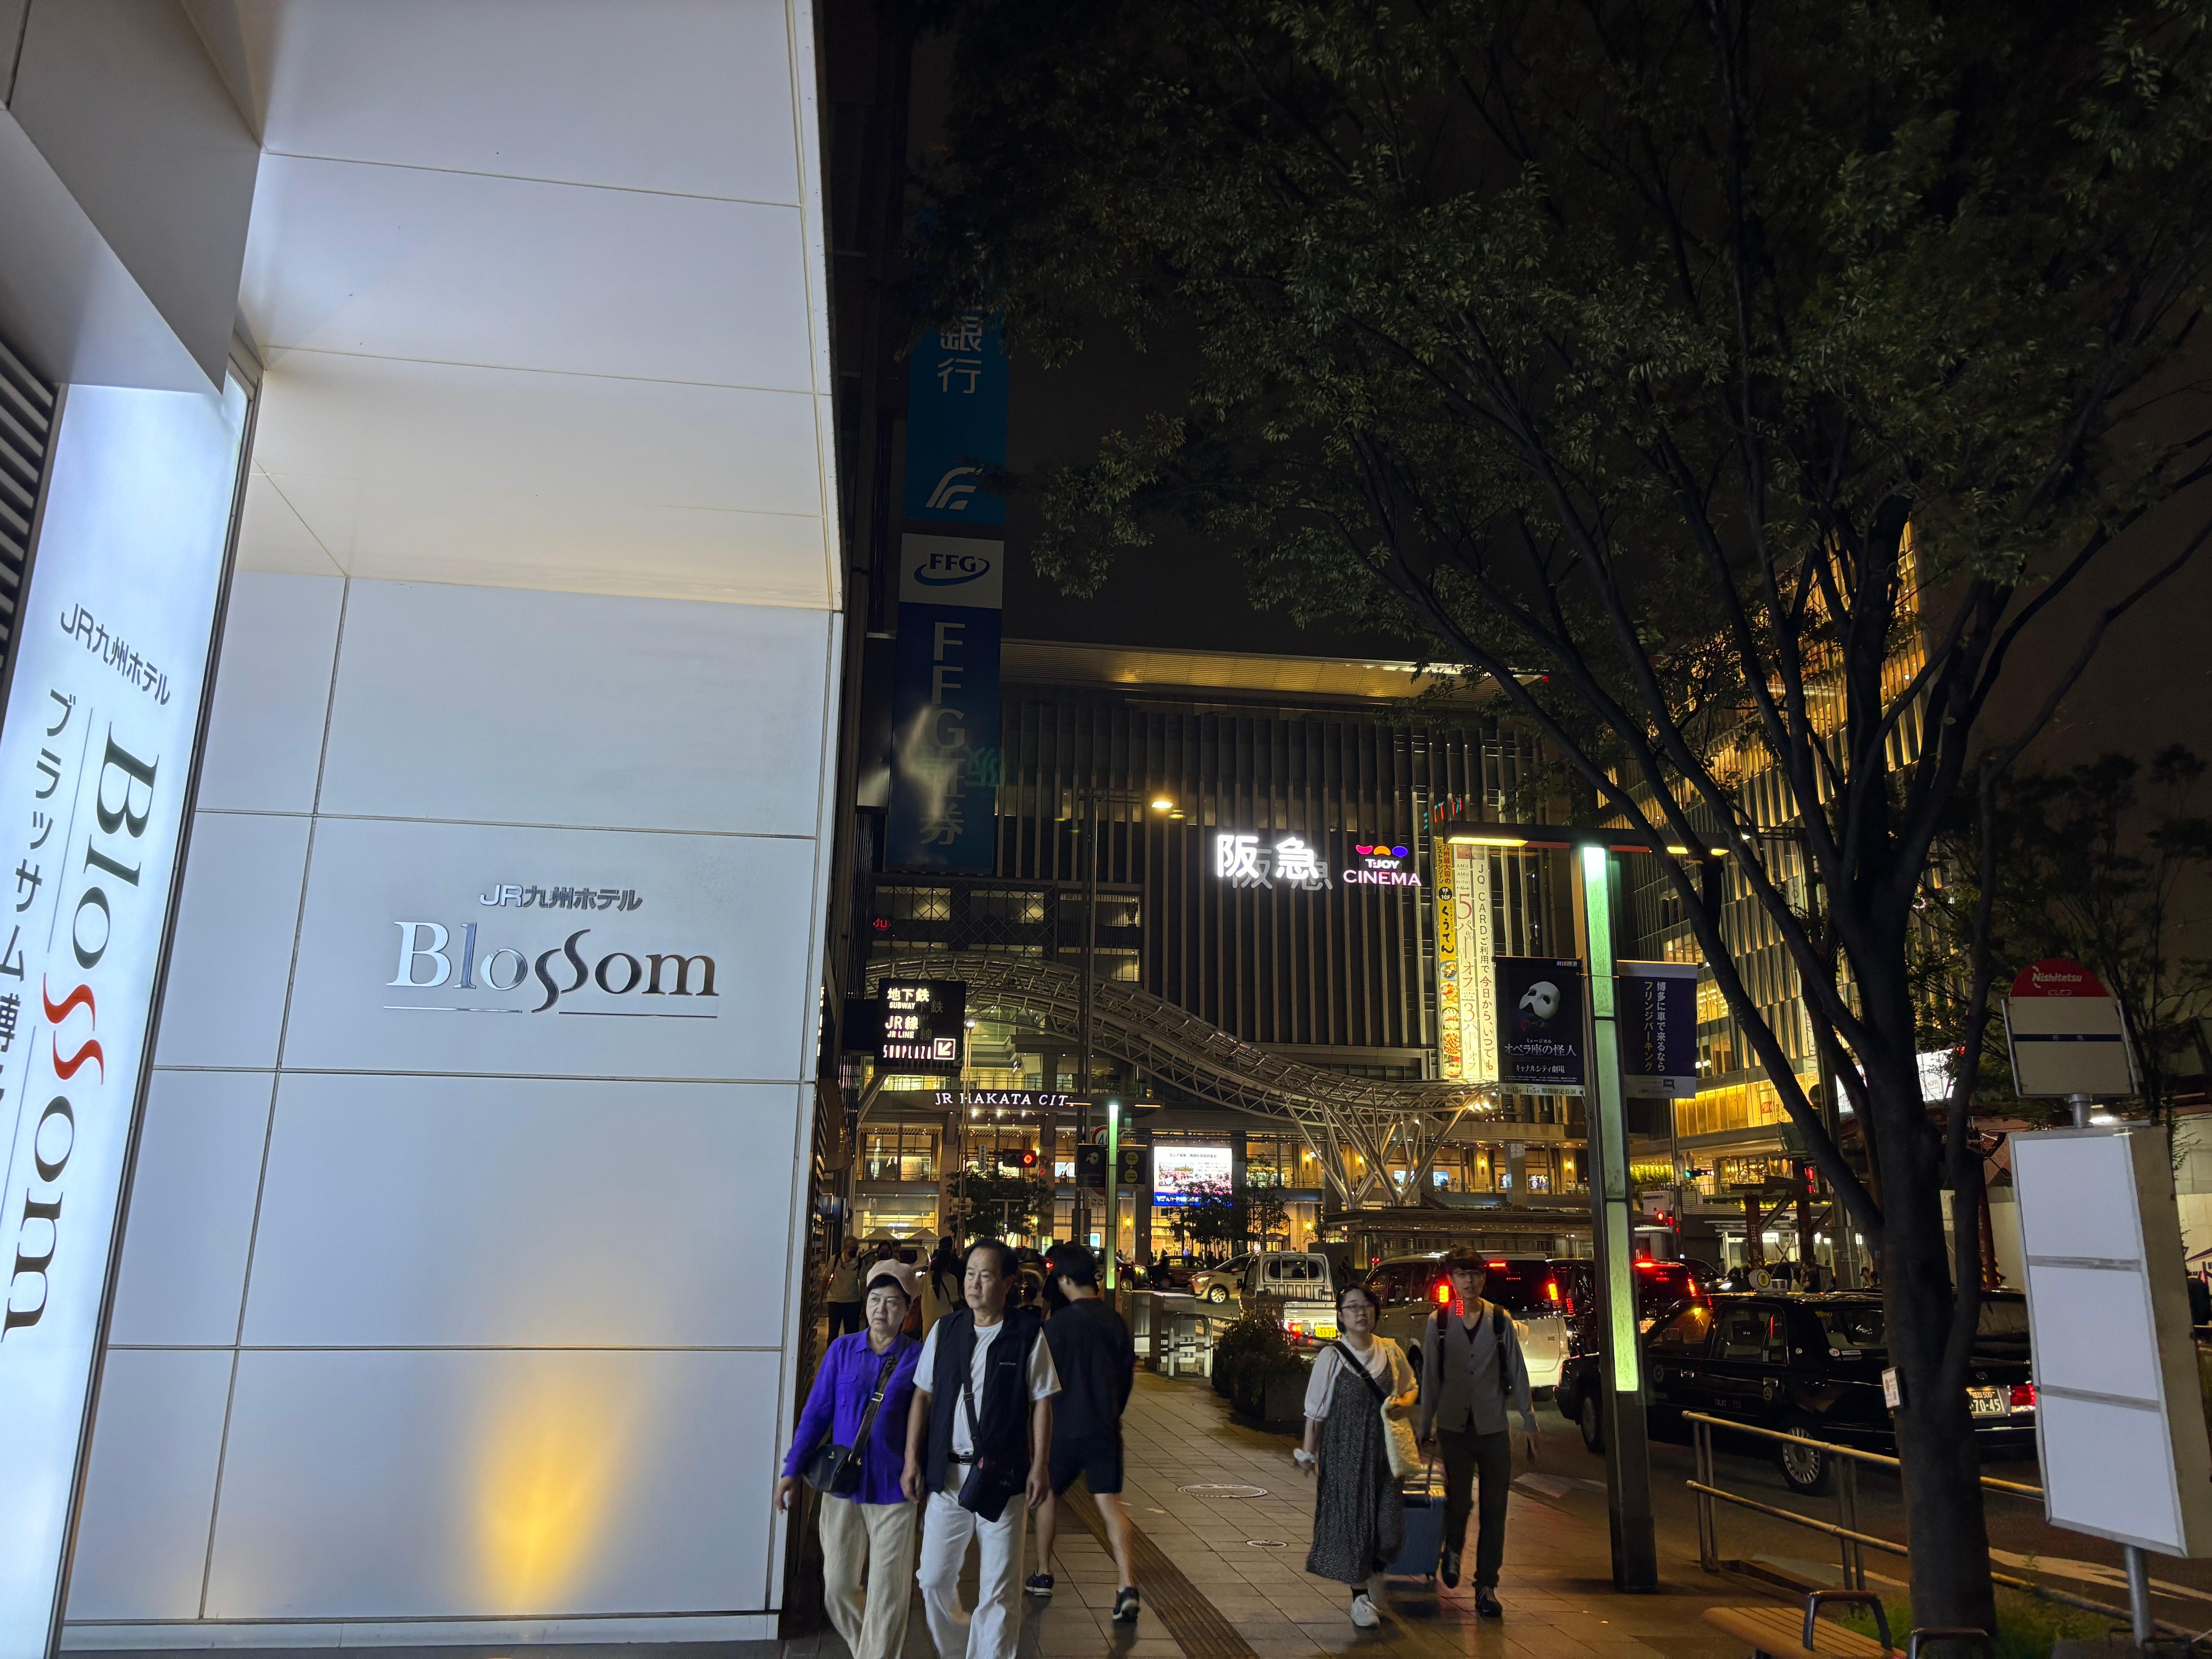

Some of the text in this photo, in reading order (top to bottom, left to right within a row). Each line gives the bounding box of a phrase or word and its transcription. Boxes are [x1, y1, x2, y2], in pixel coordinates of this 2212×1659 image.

[929, 553, 977, 572] FFG
[61, 603, 171, 706] JR九州ホテル
[1217, 834, 1320, 880] 阪急
[1343, 870, 1421, 887] CINEMA
[479, 884, 643, 911] JR九州ホテル
[1441, 906, 1455, 954] くうてん
[386, 921, 720, 1014] Blossom
[2032, 972, 2082, 983] Nishitetsu
[887, 987, 929, 1003] 地下鉄
[889, 1001, 916, 1010] SUBWAY
[885, 1016, 919, 1030] JR線
[1656, 981, 1667, 1071] 博多に車で来るなら
[1, 721, 160, 1343] Blossom
[887, 1030, 915, 1039] JR LINE
[1504, 1043, 1577, 1056] オペラ座の怪人
[1516, 1064, 1565, 1074] キャナルシティ劇場
[935, 1093, 1074, 1106] JR HAKATA CIT
[1973, 1398, 2001, 1412] 70-45
